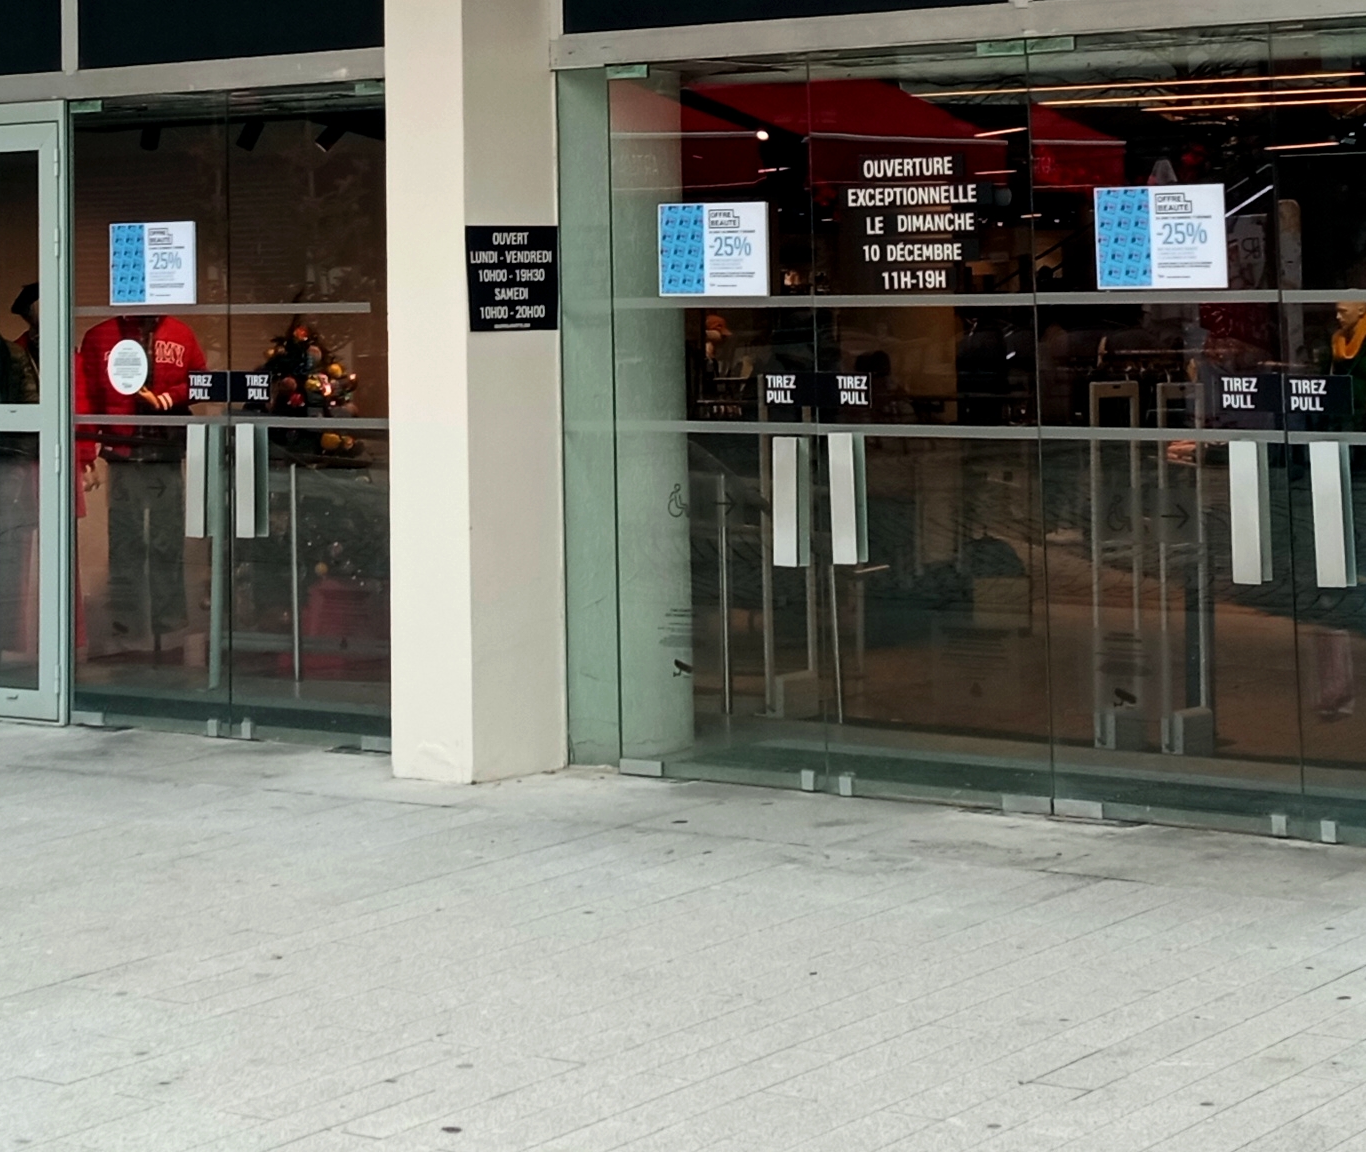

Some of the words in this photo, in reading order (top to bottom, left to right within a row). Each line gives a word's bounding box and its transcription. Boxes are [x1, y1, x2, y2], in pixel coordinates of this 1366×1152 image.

[863, 156, 953, 178] OUVERTURE
[847, 184, 977, 207] EXCEPTIONNELLE
[866, 216, 884, 235] LE
[897, 213, 975, 233] DIMANCHE
[492, 232, 529, 245] OUVERT
[1156, 222, 1208, 245] -25%
[709, 236, 752, 257] -25%
[863, 245, 880, 262] 10
[887, 242, 962, 261] DÉCEMBRE
[148, 251, 182, 270] -25%
[470, 250, 498, 264] LUNDI
[505, 250, 552, 263] VENDREDI
[478, 269, 507, 282] 10H00
[515, 268, 545, 282] 19H30
[882, 270, 947, 290] 11H-19H
[494, 287, 529, 301] SAMEDI
[479, 306, 508, 319] 10H00
[515, 305, 546, 319] 20H00
[188, 374, 213, 387] TIREZ
[245, 374, 269, 387] TIREZ
[766, 374, 796, 388] TIREZ
[836, 375, 868, 390] TIREZ
[1221, 377, 1258, 392] TIREZ
[1289, 379, 1327, 395] TIREZ
[188, 388, 210, 400] PULL
[247, 388, 269, 400] PULL
[766, 390, 794, 403] PULL
[840, 391, 868, 405] PULL
[1222, 394, 1255, 409] PULL
[1290, 396, 1324, 411] PULL
